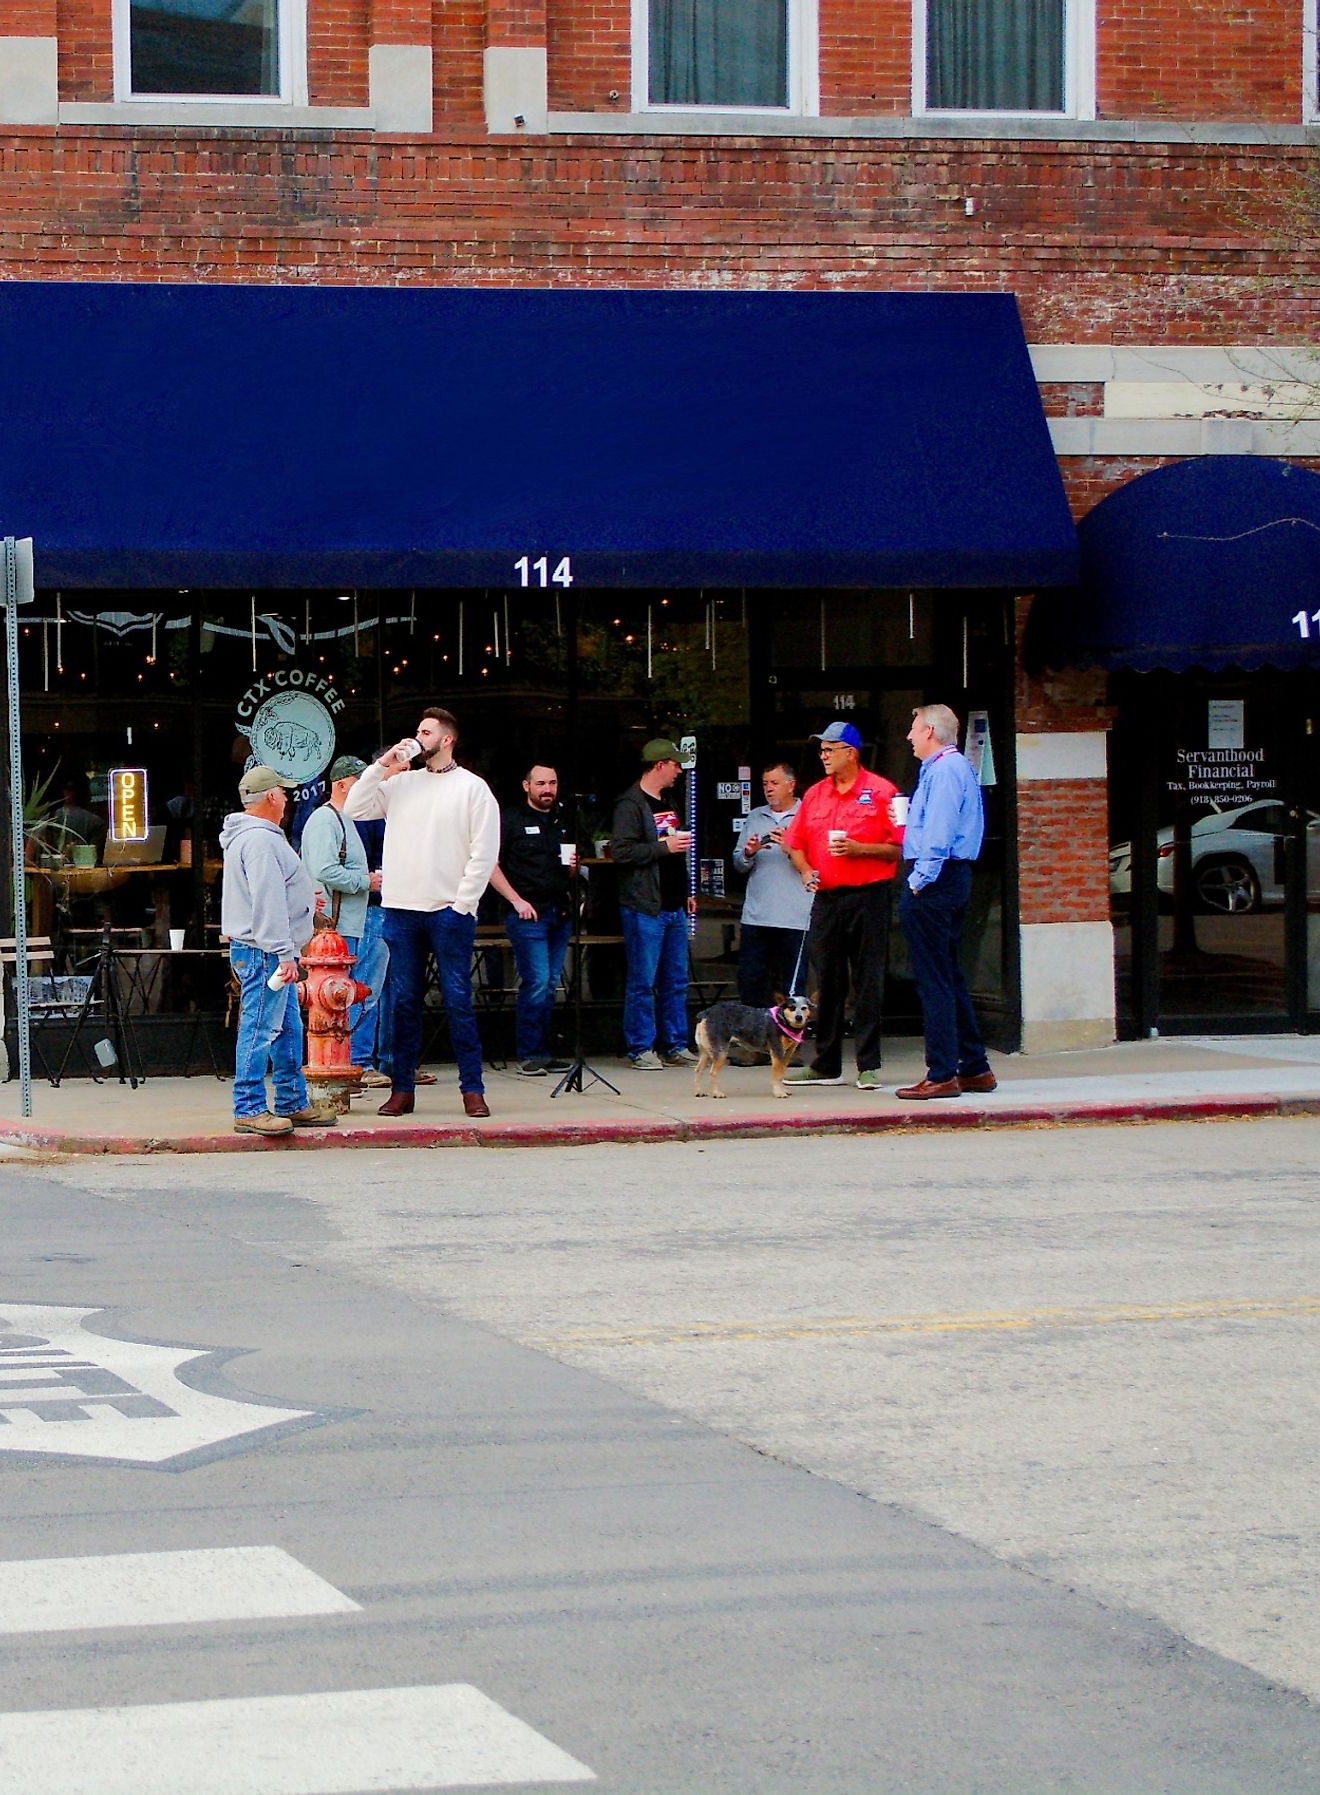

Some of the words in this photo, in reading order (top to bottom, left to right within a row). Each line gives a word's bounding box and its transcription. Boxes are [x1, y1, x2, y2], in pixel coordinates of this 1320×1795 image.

[514, 556, 573, 588] 114
[237, 678, 272, 718] CTX
[274, 669, 346, 715] COFFEE
[1177, 748, 1265, 763] Servanthood
[1188, 764, 1255, 779] Financial
[292, 781, 327, 802] 2017
[1246, 780, 1277, 791] Payroll
[121, 772, 137, 838] OPEN
